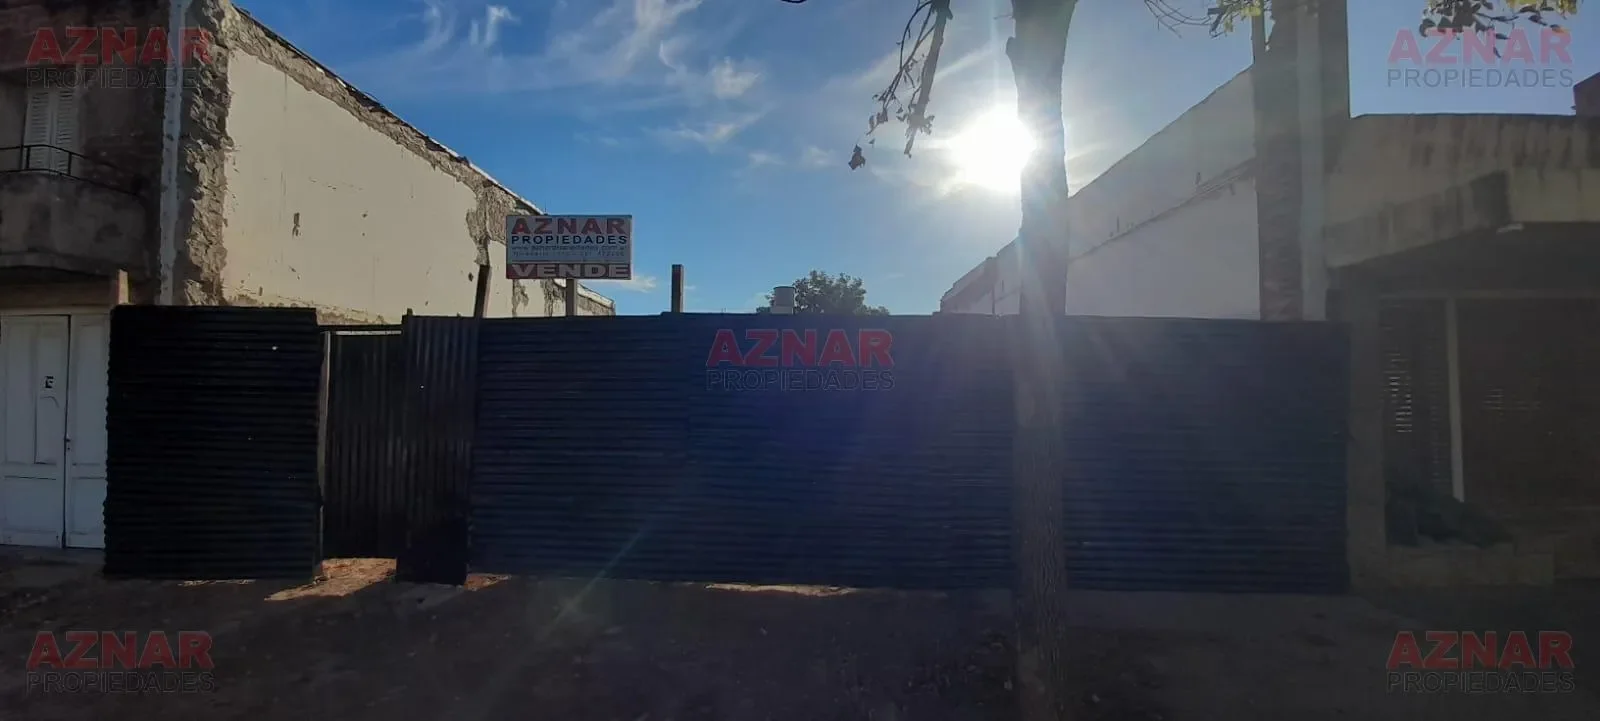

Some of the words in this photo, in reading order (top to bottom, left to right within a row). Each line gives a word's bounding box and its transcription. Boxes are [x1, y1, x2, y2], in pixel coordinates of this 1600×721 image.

[511, 217, 628, 234] AZNAR
[511, 235, 628, 245] PROPIEDADES
[511, 264, 629, 277] VENDE
